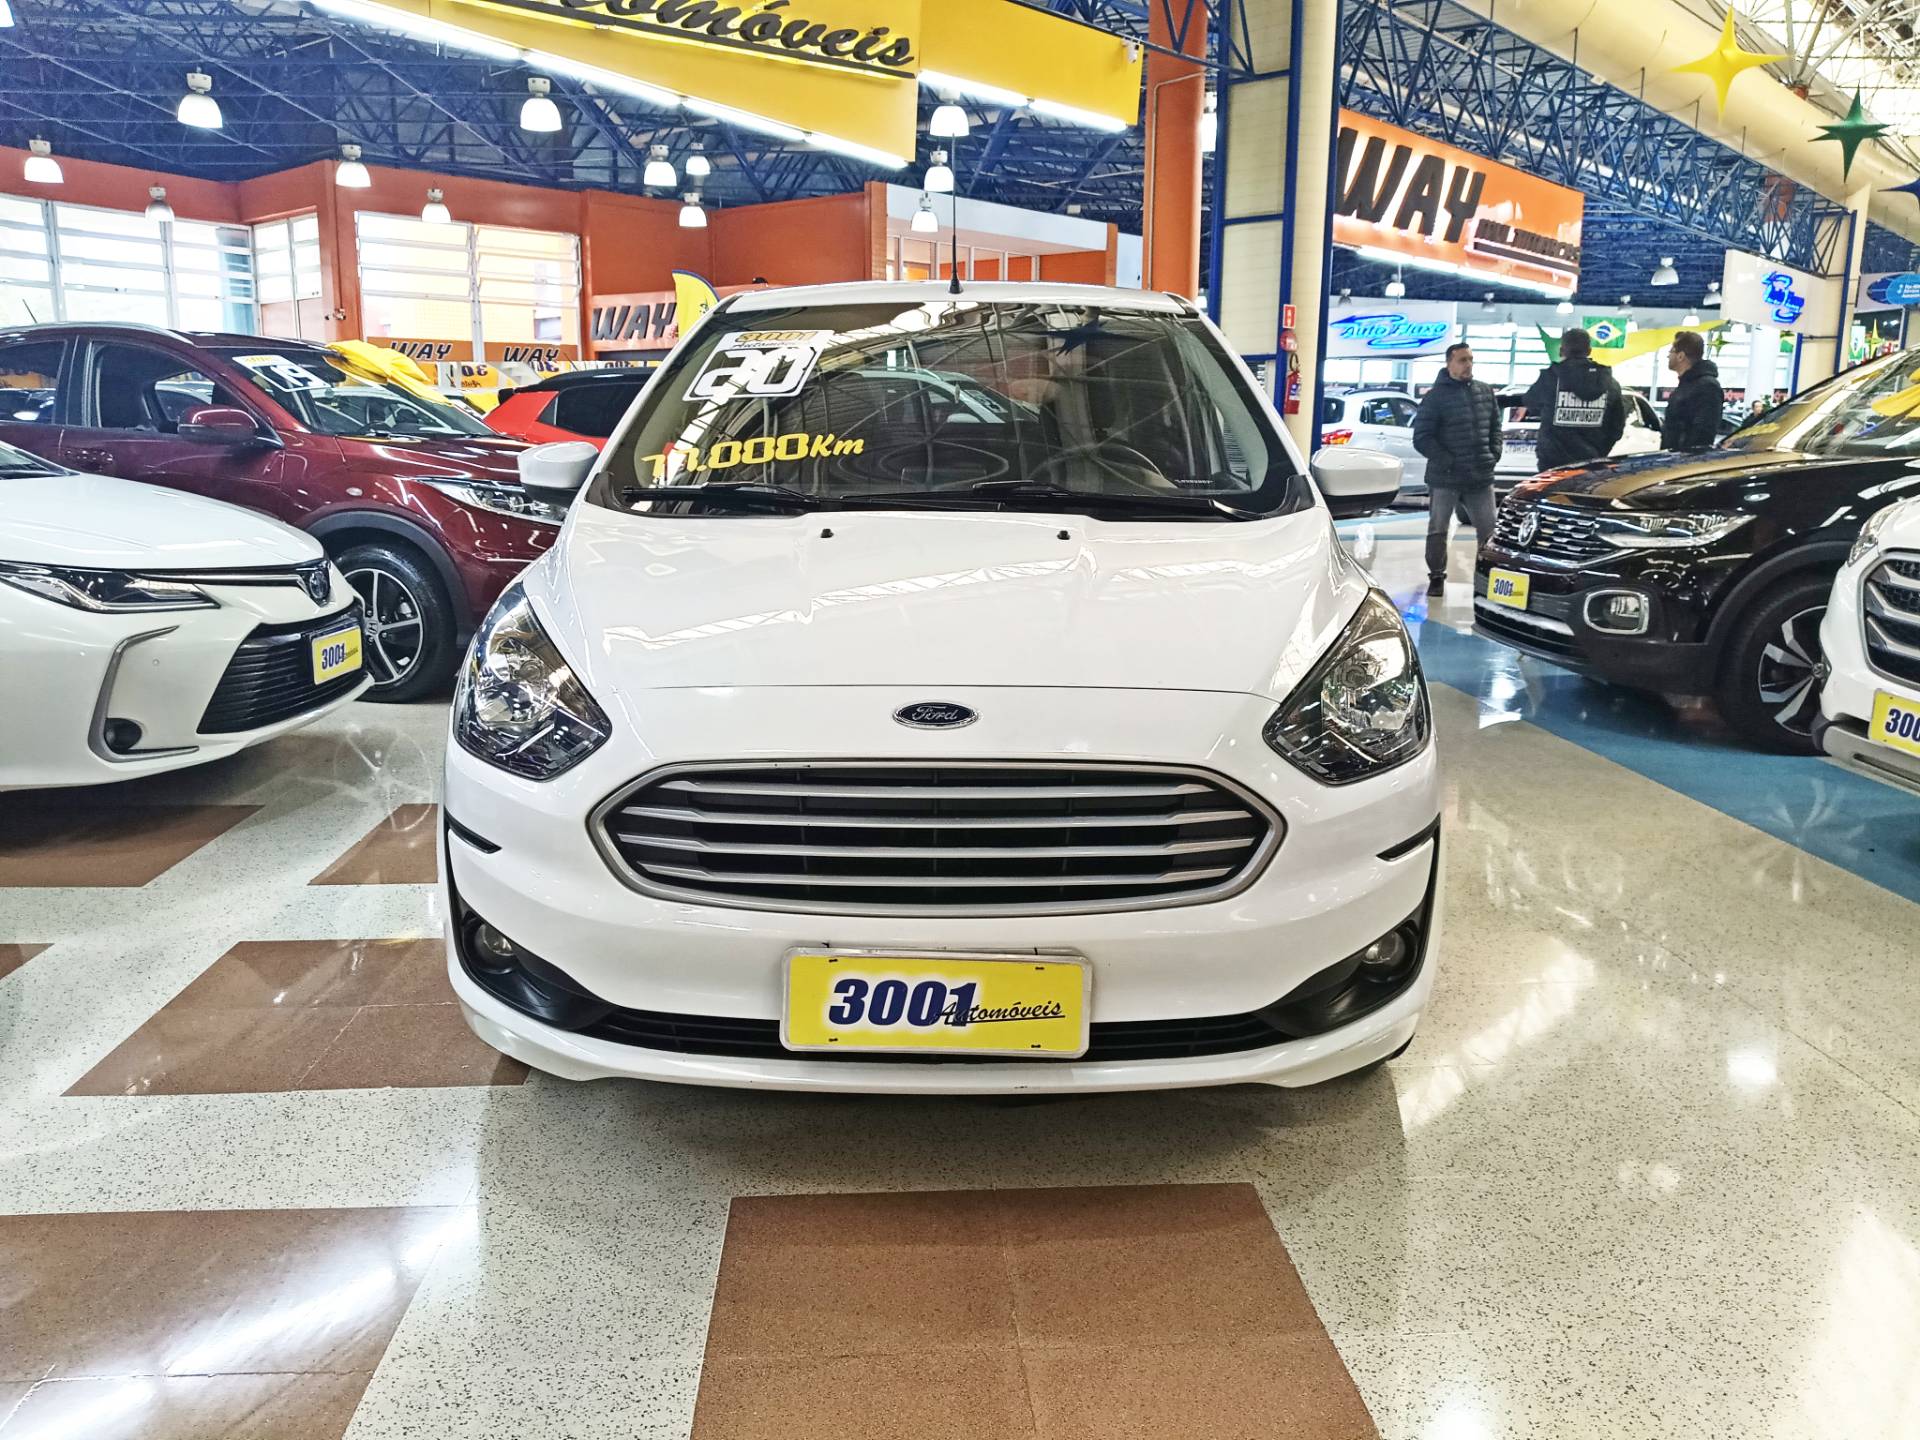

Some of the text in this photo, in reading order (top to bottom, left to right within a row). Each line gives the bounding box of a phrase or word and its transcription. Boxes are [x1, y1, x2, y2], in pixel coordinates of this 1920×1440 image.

[1333, 126, 1487, 243] WAY
[591, 302, 678, 341] WAY
[391, 342, 452, 360] WAY
[502, 345, 560, 362] WAY
[694, 347, 817, 396] 20
[1558, 409, 1602, 422] CHAMPIONSHIP
[1493, 578, 1514, 597] 3001
[321, 643, 346, 671] 3001
[912, 705, 959, 721] Ford
[828, 978, 1065, 1027] 3001 Automóveis
